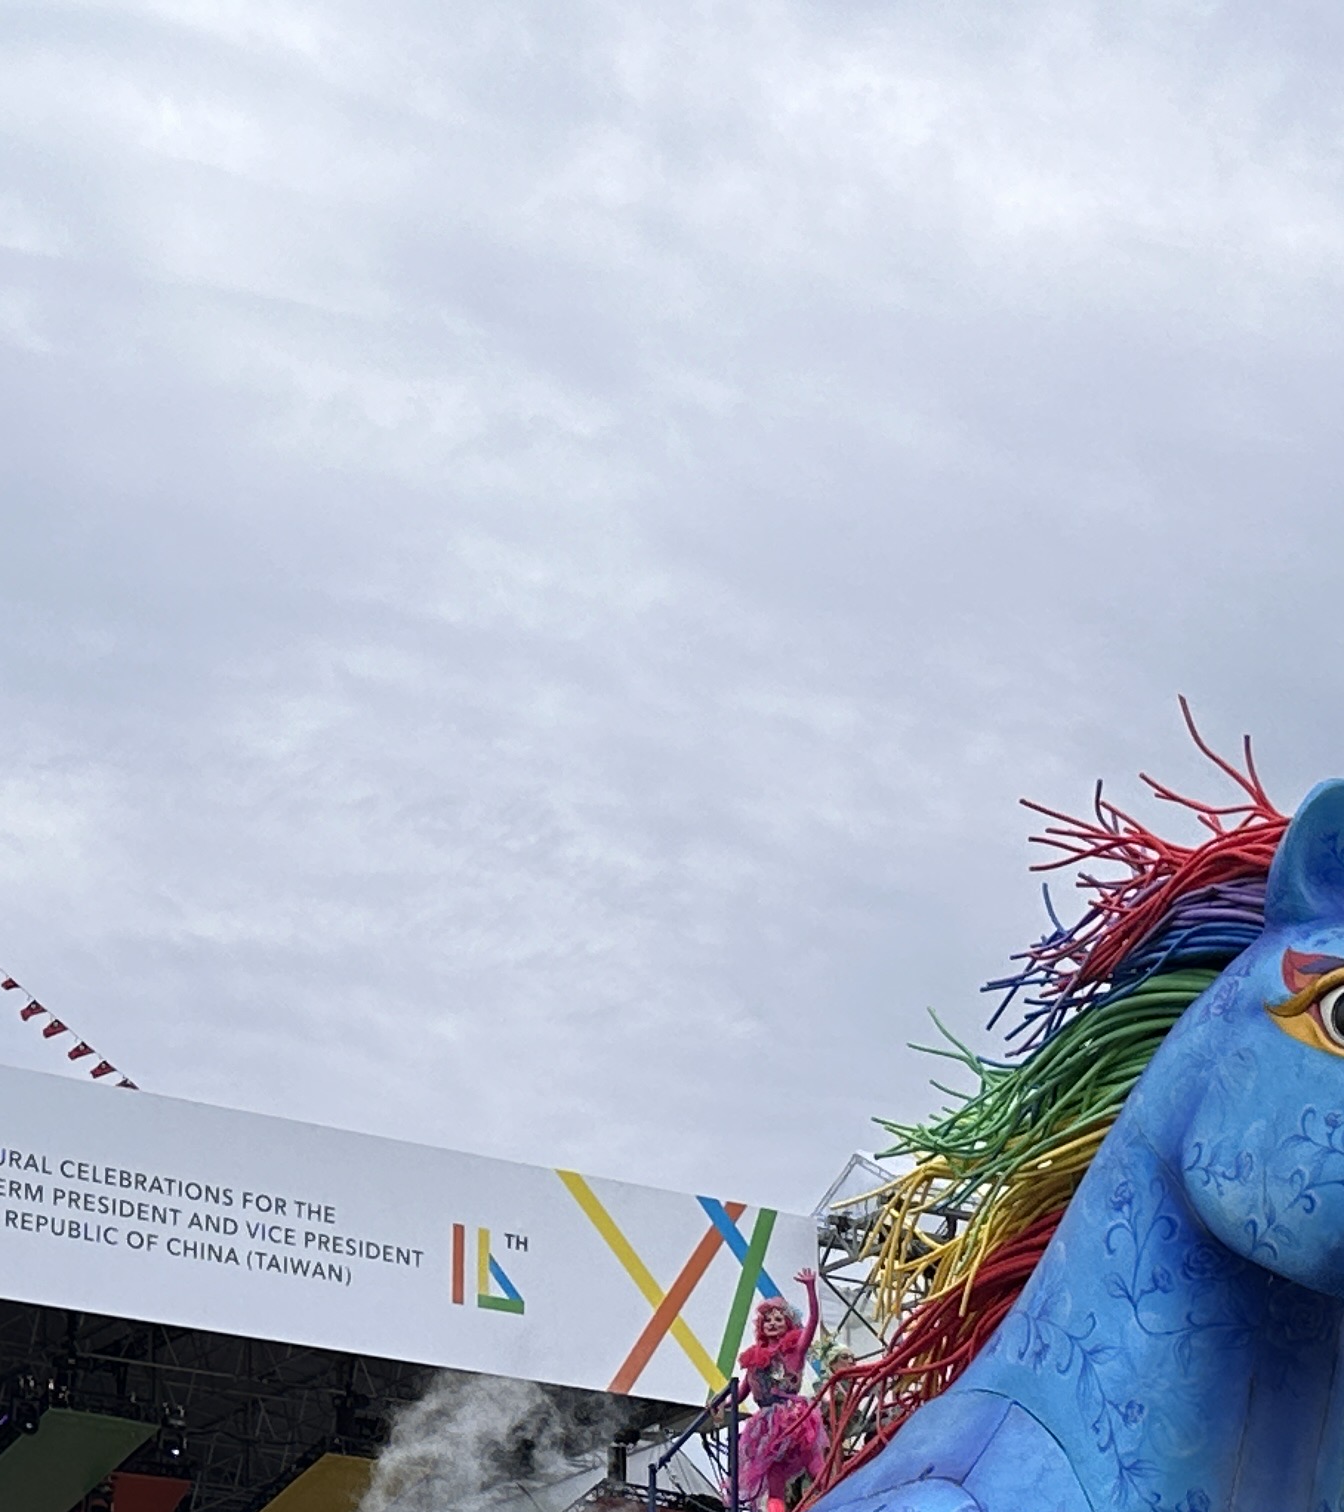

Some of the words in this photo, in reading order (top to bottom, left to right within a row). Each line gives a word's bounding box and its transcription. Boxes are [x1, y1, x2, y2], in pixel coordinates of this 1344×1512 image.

[52, 1187, 183, 1227] PRESIDENT
[187, 1212, 239, 1236] AND
[245, 1220, 297, 1247] VICE
[304, 1230, 425, 1268] PRESIDENT
[59, 1159, 234, 1207] CELEBRATIONS
[242, 1191, 287, 1217] FOR
[293, 1199, 336, 1225] THE
[5, 1209, 119, 1246] REPUBLIC
[126, 1230, 159, 1252] OF
[166, 1237, 241, 1266] CHINA
[246, 1249, 352, 1287] (TAIWAN)
[504, 1232, 529, 1252] TH
